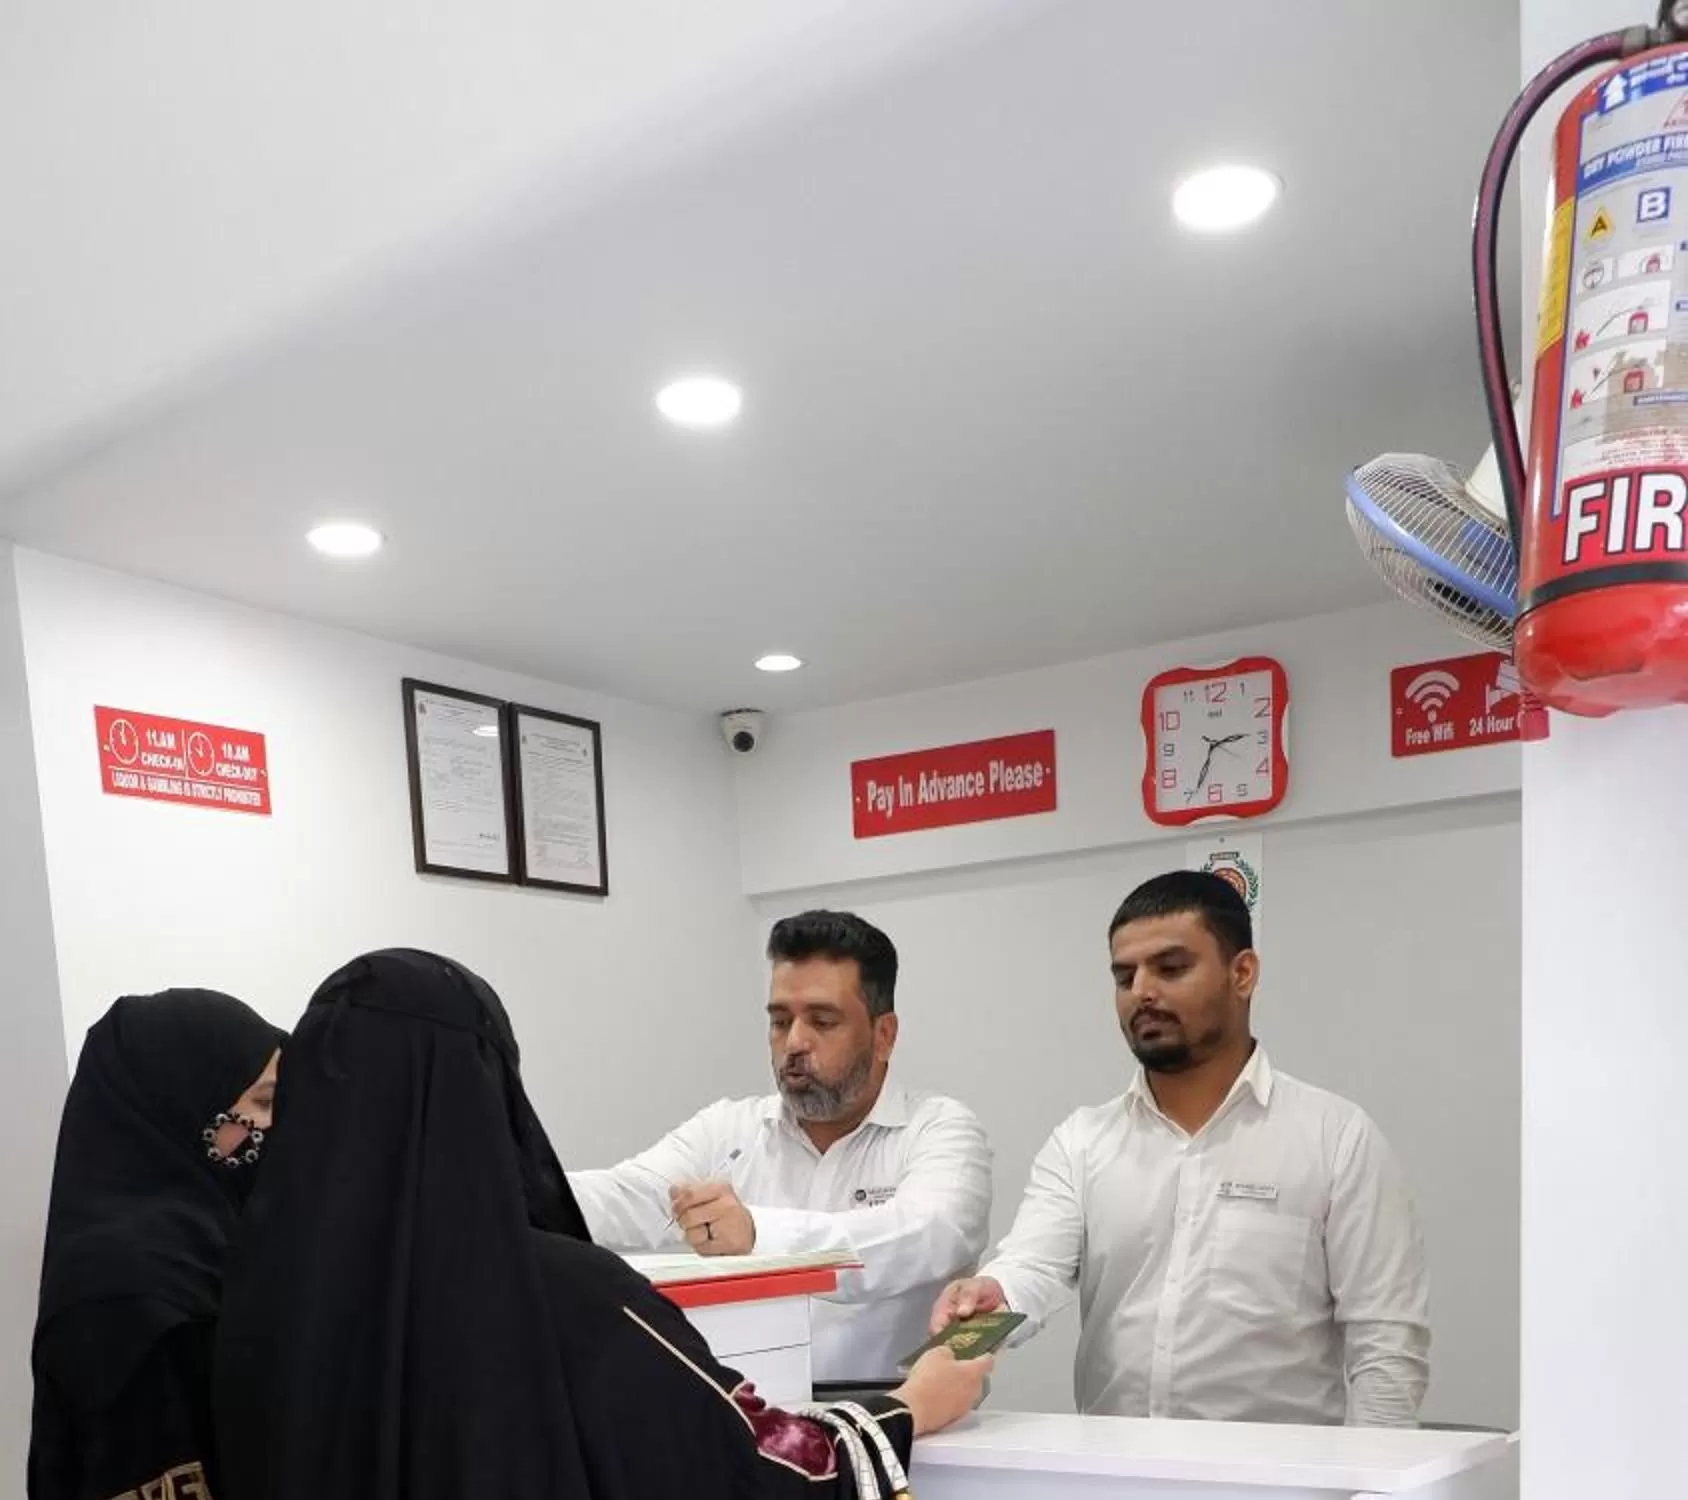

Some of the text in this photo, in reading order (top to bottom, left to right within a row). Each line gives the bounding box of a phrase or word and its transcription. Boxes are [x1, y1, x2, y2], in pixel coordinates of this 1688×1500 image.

[1607, 138, 1662, 167] POWDER
[1639, 191, 1667, 221] B
[1590, 216, 1608, 238] A
[1204, 681, 1228, 703] 12
[1254, 697, 1272, 719] 2
[1158, 710, 1181, 732] 10
[1469, 718, 1483, 737] 24
[1487, 715, 1515, 734] Hour
[1256, 730, 1269, 745] 3
[1405, 721, 1455, 746] Free Wifi
[1163, 743, 1175, 757] 9
[1255, 757, 1270, 775] 4
[866, 759, 1044, 819] Pay In Advance Please
[1161, 769, 1177, 789] 8
[1236, 783, 1249, 797] 5
[1207, 784, 1223, 803] 6
